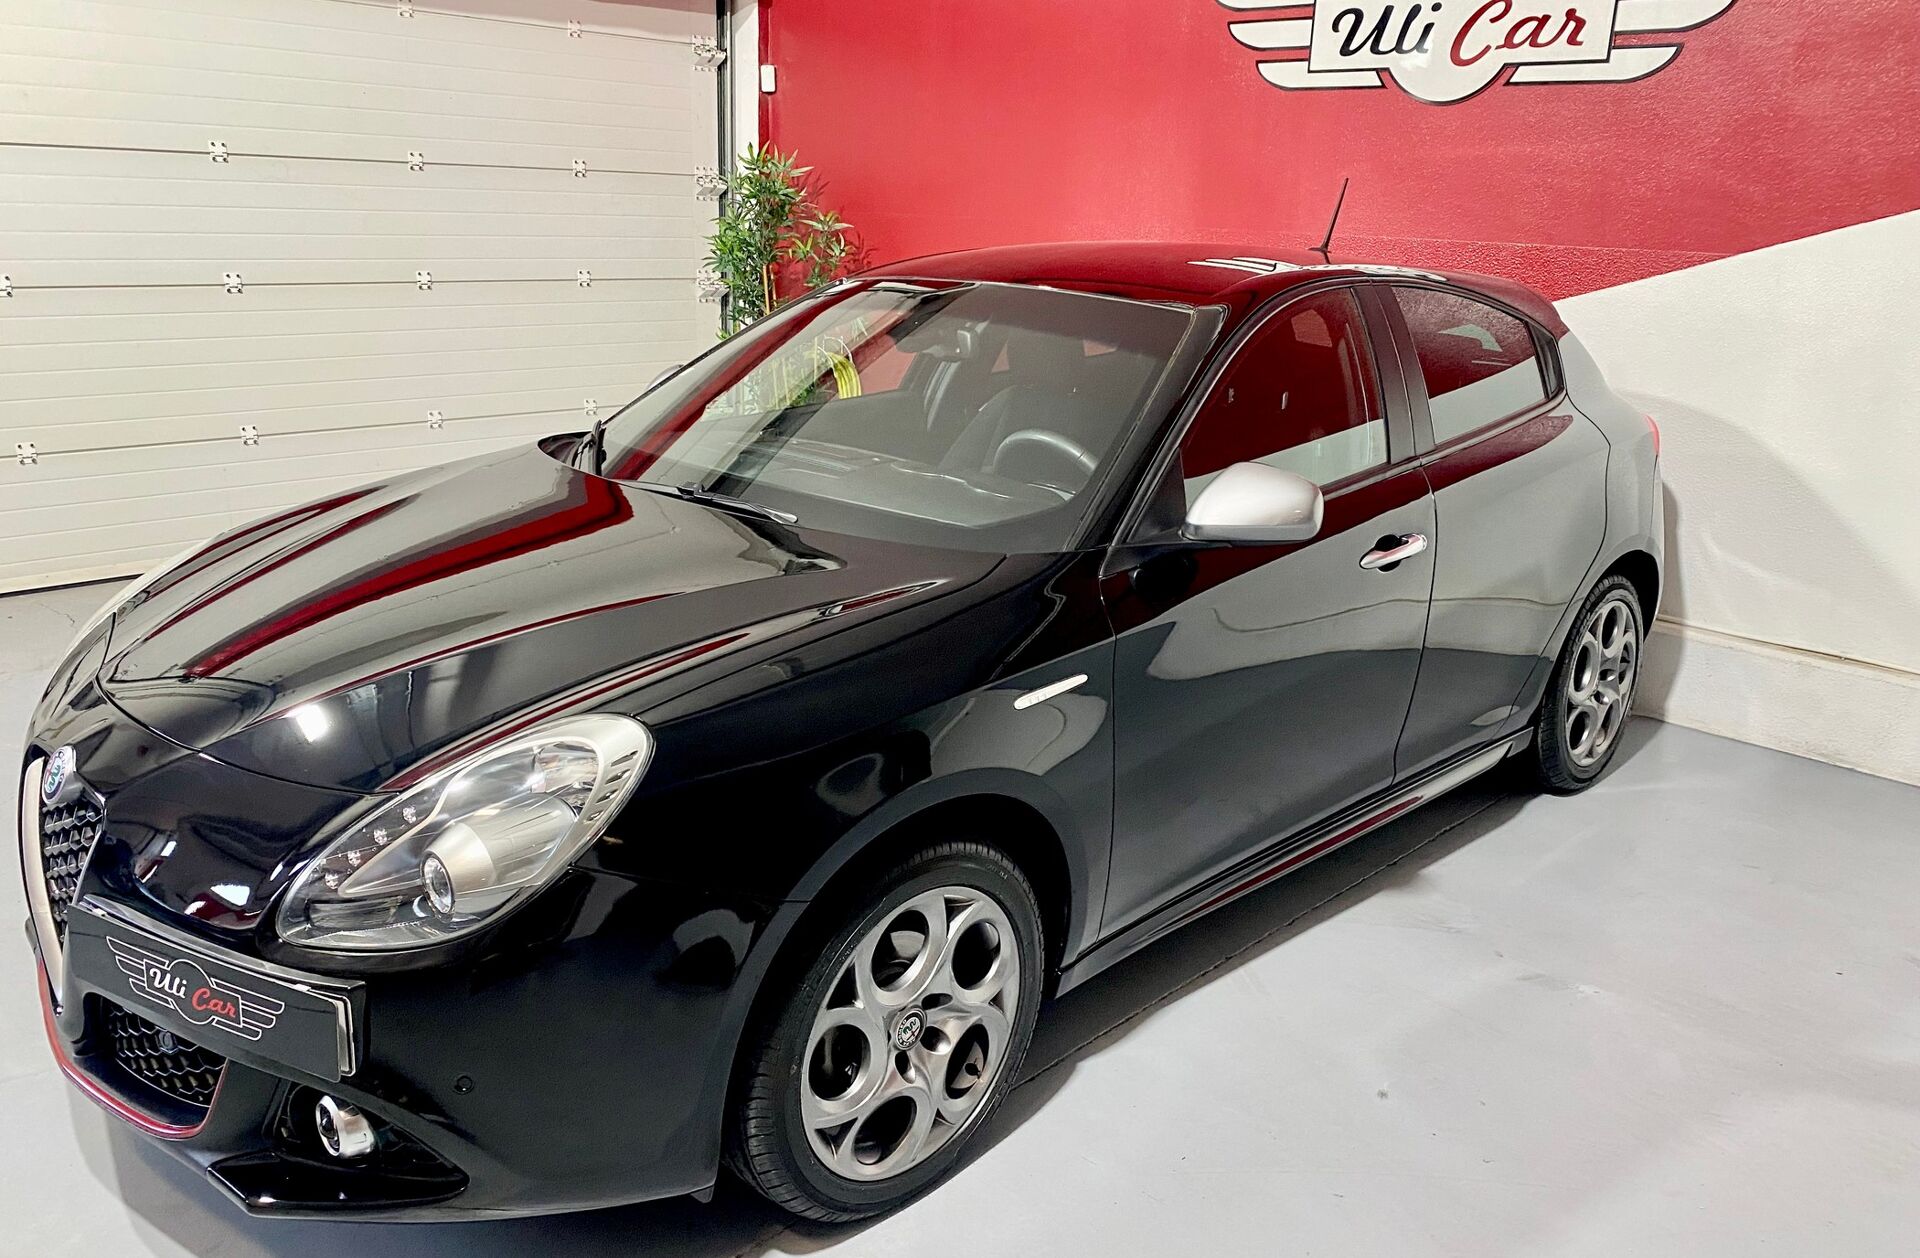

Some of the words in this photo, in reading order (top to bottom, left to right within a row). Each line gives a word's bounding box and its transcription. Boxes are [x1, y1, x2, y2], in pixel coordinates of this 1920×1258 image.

[1331, 2, 1443, 57] Uli
[1450, 0, 1588, 67] Car
[149, 967, 188, 999] Uli
[191, 987, 236, 1018] Car
